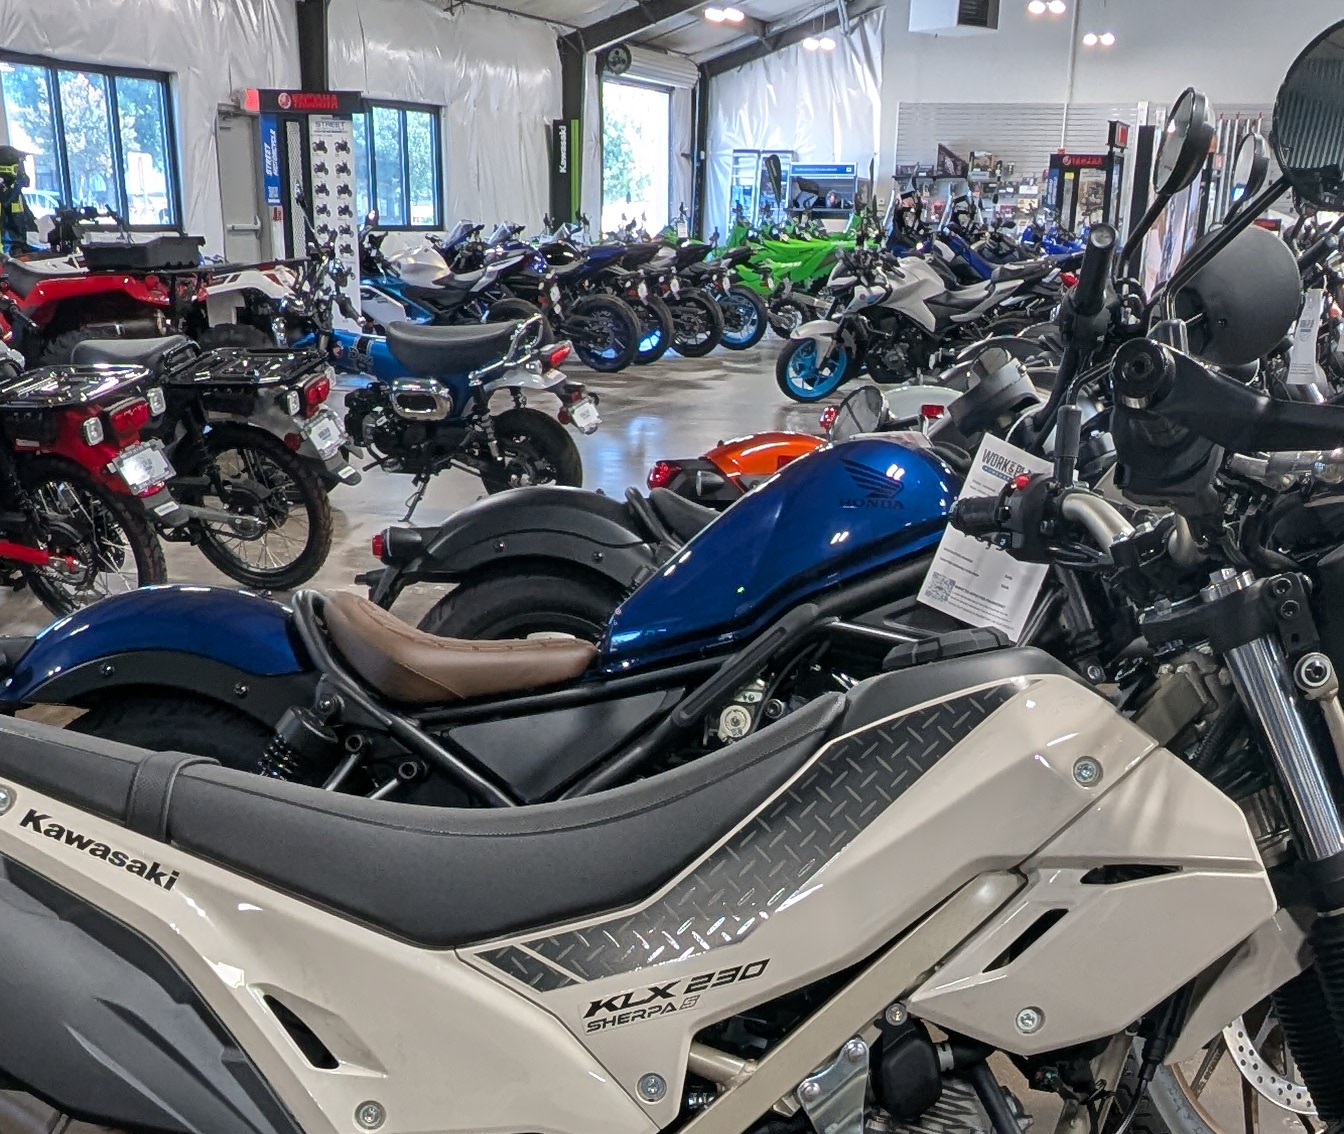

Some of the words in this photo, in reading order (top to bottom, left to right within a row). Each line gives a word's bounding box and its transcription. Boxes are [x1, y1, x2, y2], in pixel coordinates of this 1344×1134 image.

[291, 93, 338, 109] YAMAHA
[559, 125, 567, 173] Kawasaki
[982, 448, 1010, 473] WORK
[839, 499, 904, 509] HONDA
[19, 808, 180, 892] Kawasaki
[583, 979, 682, 1019] KLX
[683, 957, 771, 994] 230
[586, 1001, 678, 1034] SHERPA
